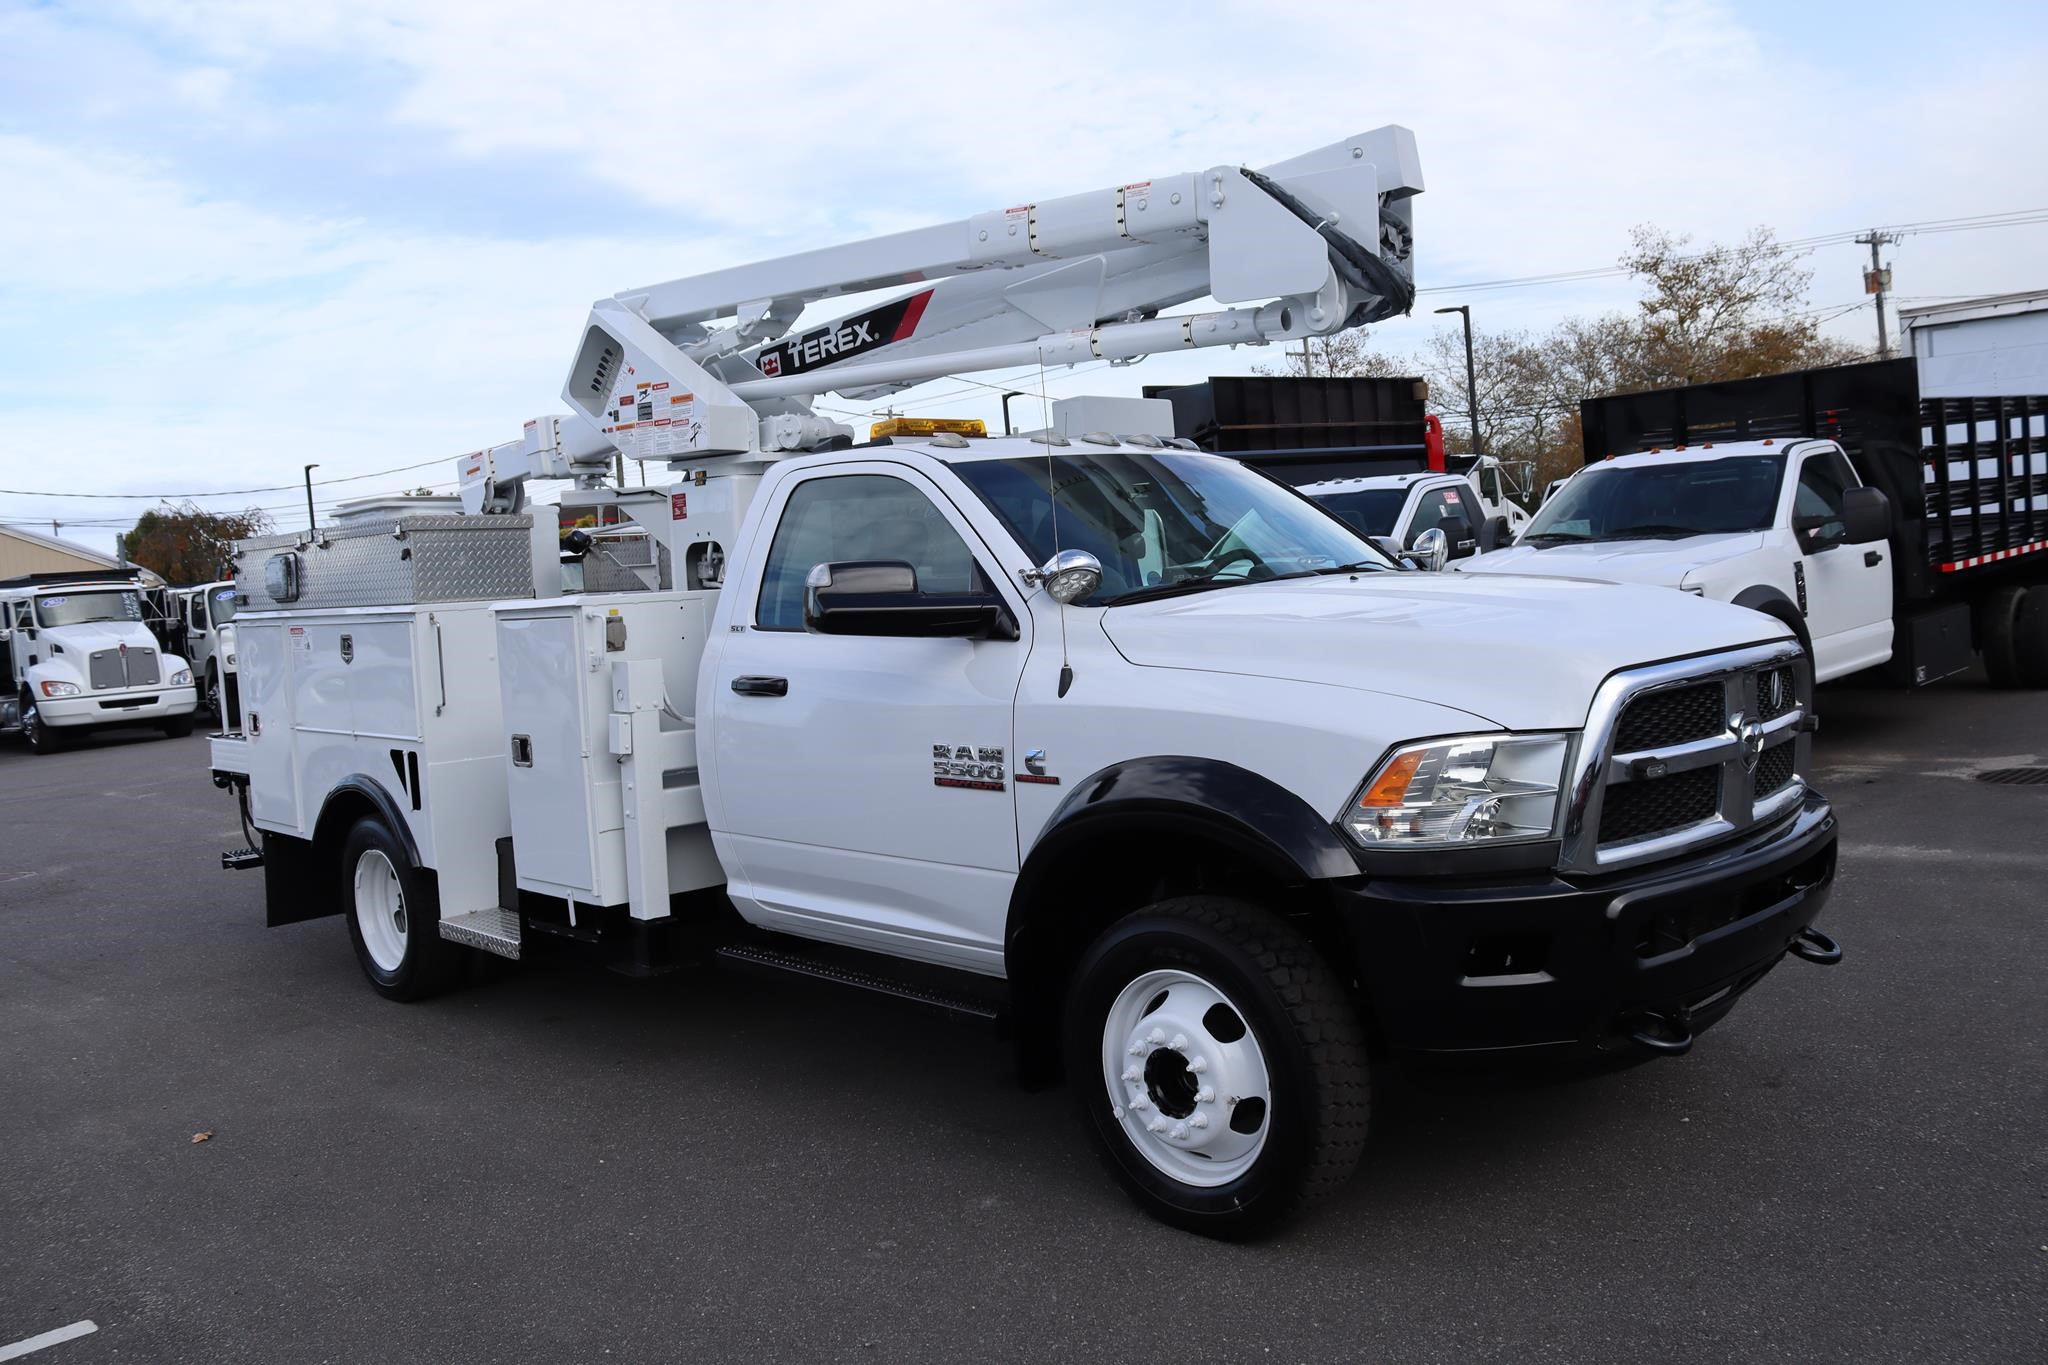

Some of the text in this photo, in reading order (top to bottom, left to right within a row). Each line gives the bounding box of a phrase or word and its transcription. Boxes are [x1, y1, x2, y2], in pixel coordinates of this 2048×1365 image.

[787, 320, 873, 368] TEREX
[933, 744, 1004, 763] RAM
[934, 761, 1005, 780] 5500
[936, 778, 1003, 790] HEAVY DUTY
